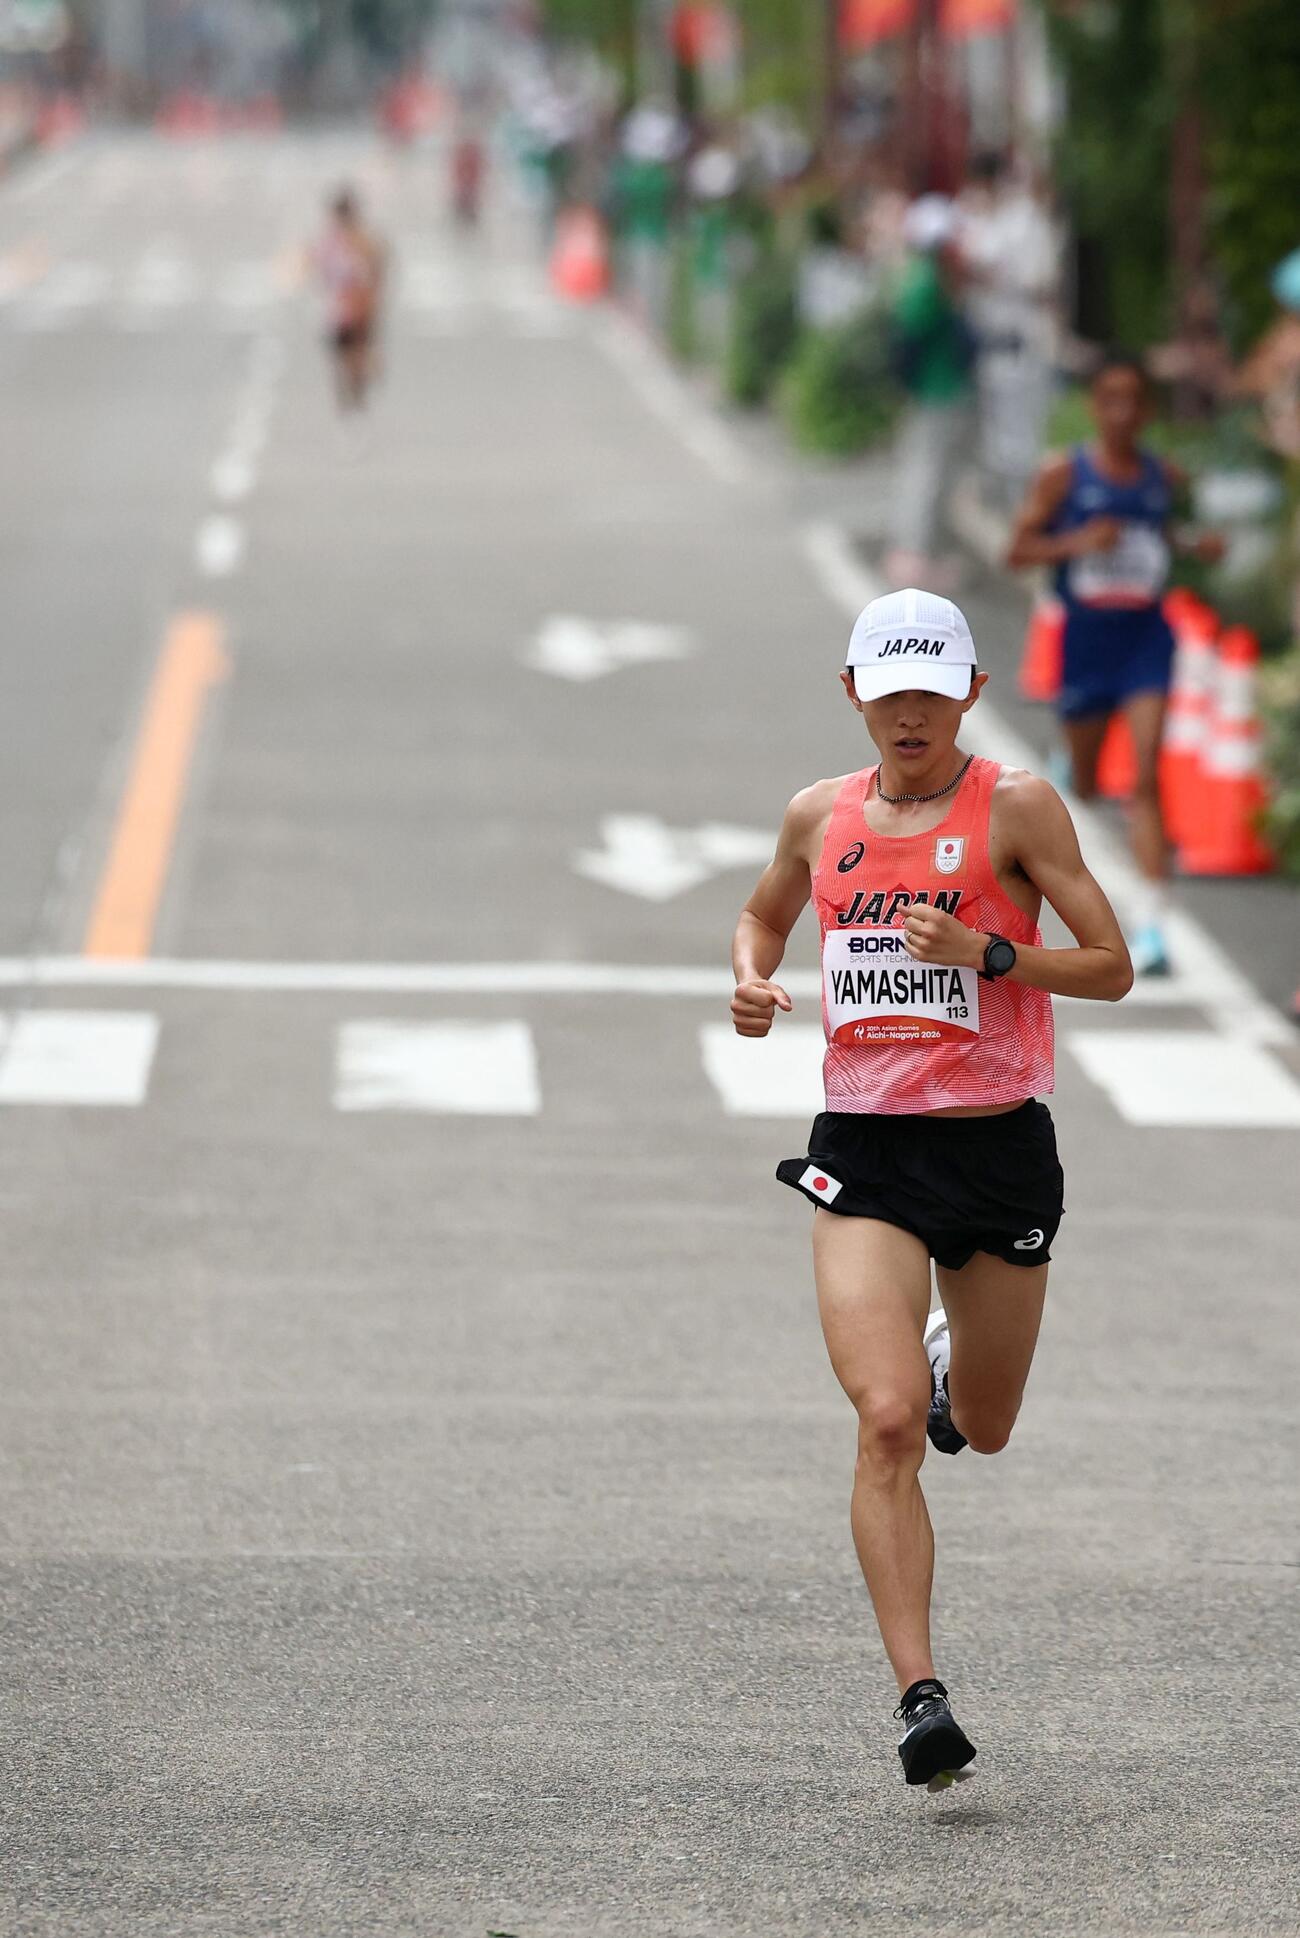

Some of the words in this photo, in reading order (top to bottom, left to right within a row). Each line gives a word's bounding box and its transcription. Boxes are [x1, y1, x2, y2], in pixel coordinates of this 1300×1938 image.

[878, 638, 946, 658] JAPAN
[847, 936, 906, 953] BORN
[849, 954, 881, 963] SPORTS
[831, 969, 966, 1005] YAMASHITA
[945, 1005, 969, 1019] 113
[866, 1032, 920, 1040] Aichi-Nagoya
